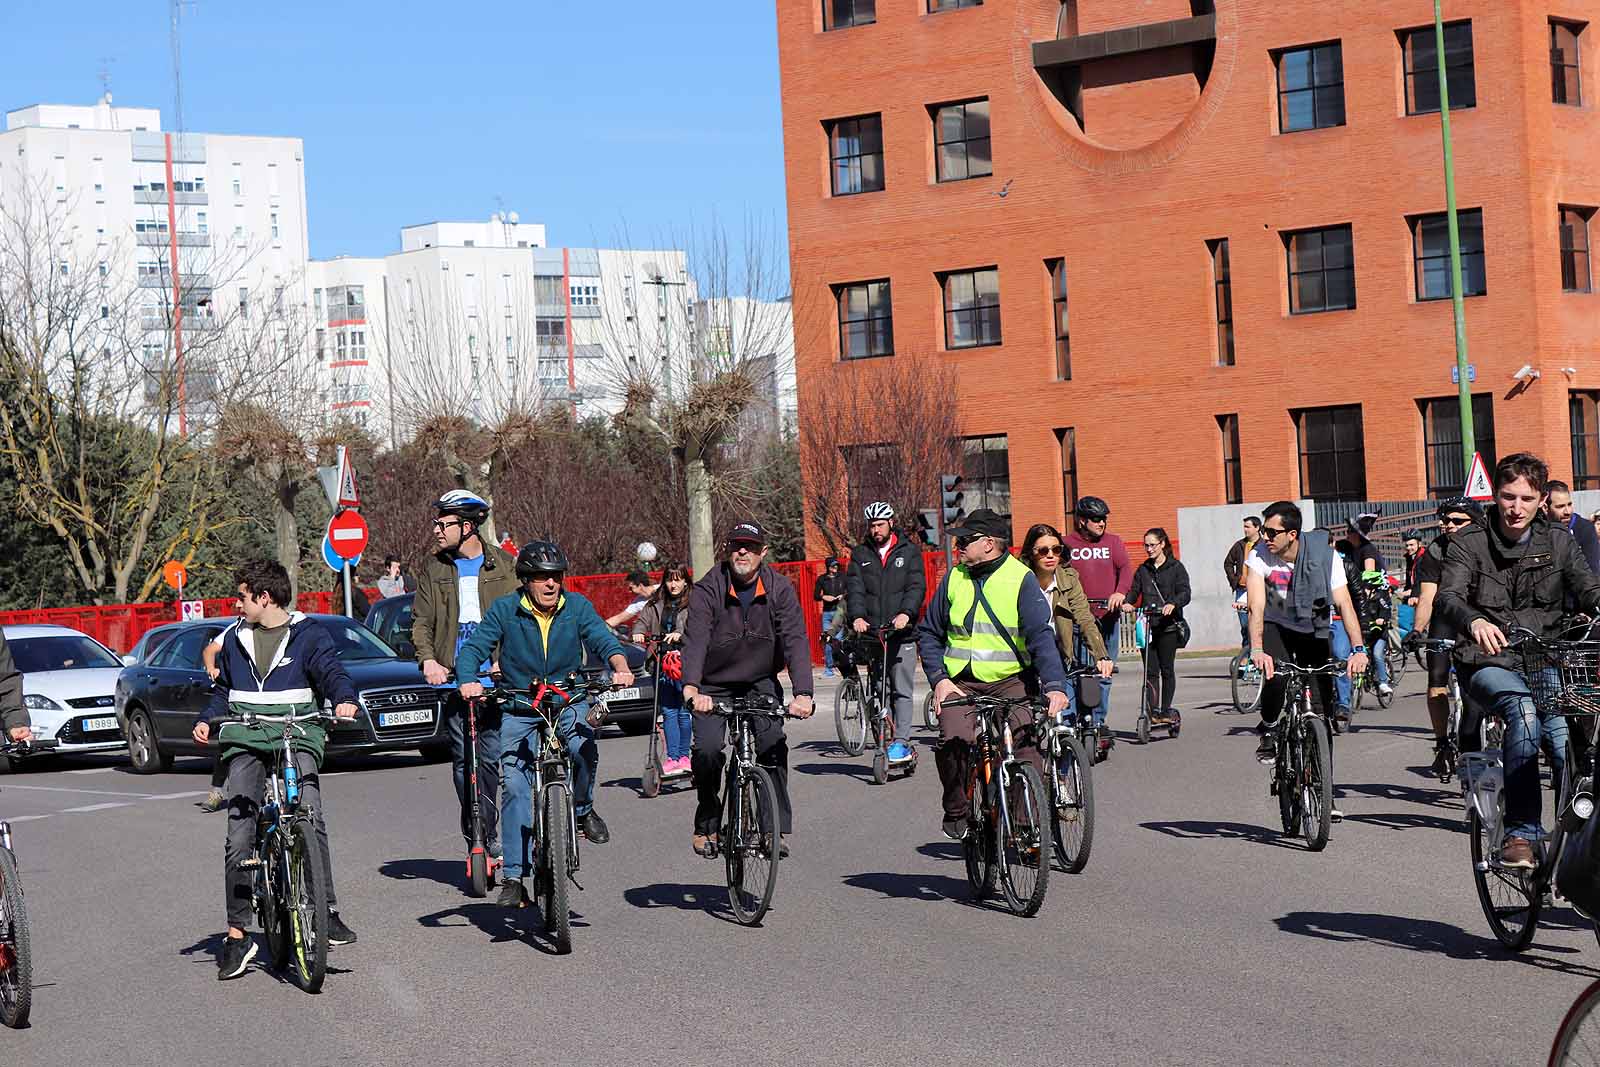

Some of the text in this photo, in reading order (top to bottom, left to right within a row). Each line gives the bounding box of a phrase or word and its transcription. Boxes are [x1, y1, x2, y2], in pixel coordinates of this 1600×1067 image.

[1071, 547, 1110, 560] CORE
[623, 689, 638, 699] DHY
[388, 711, 430, 724] 8806 GGM
